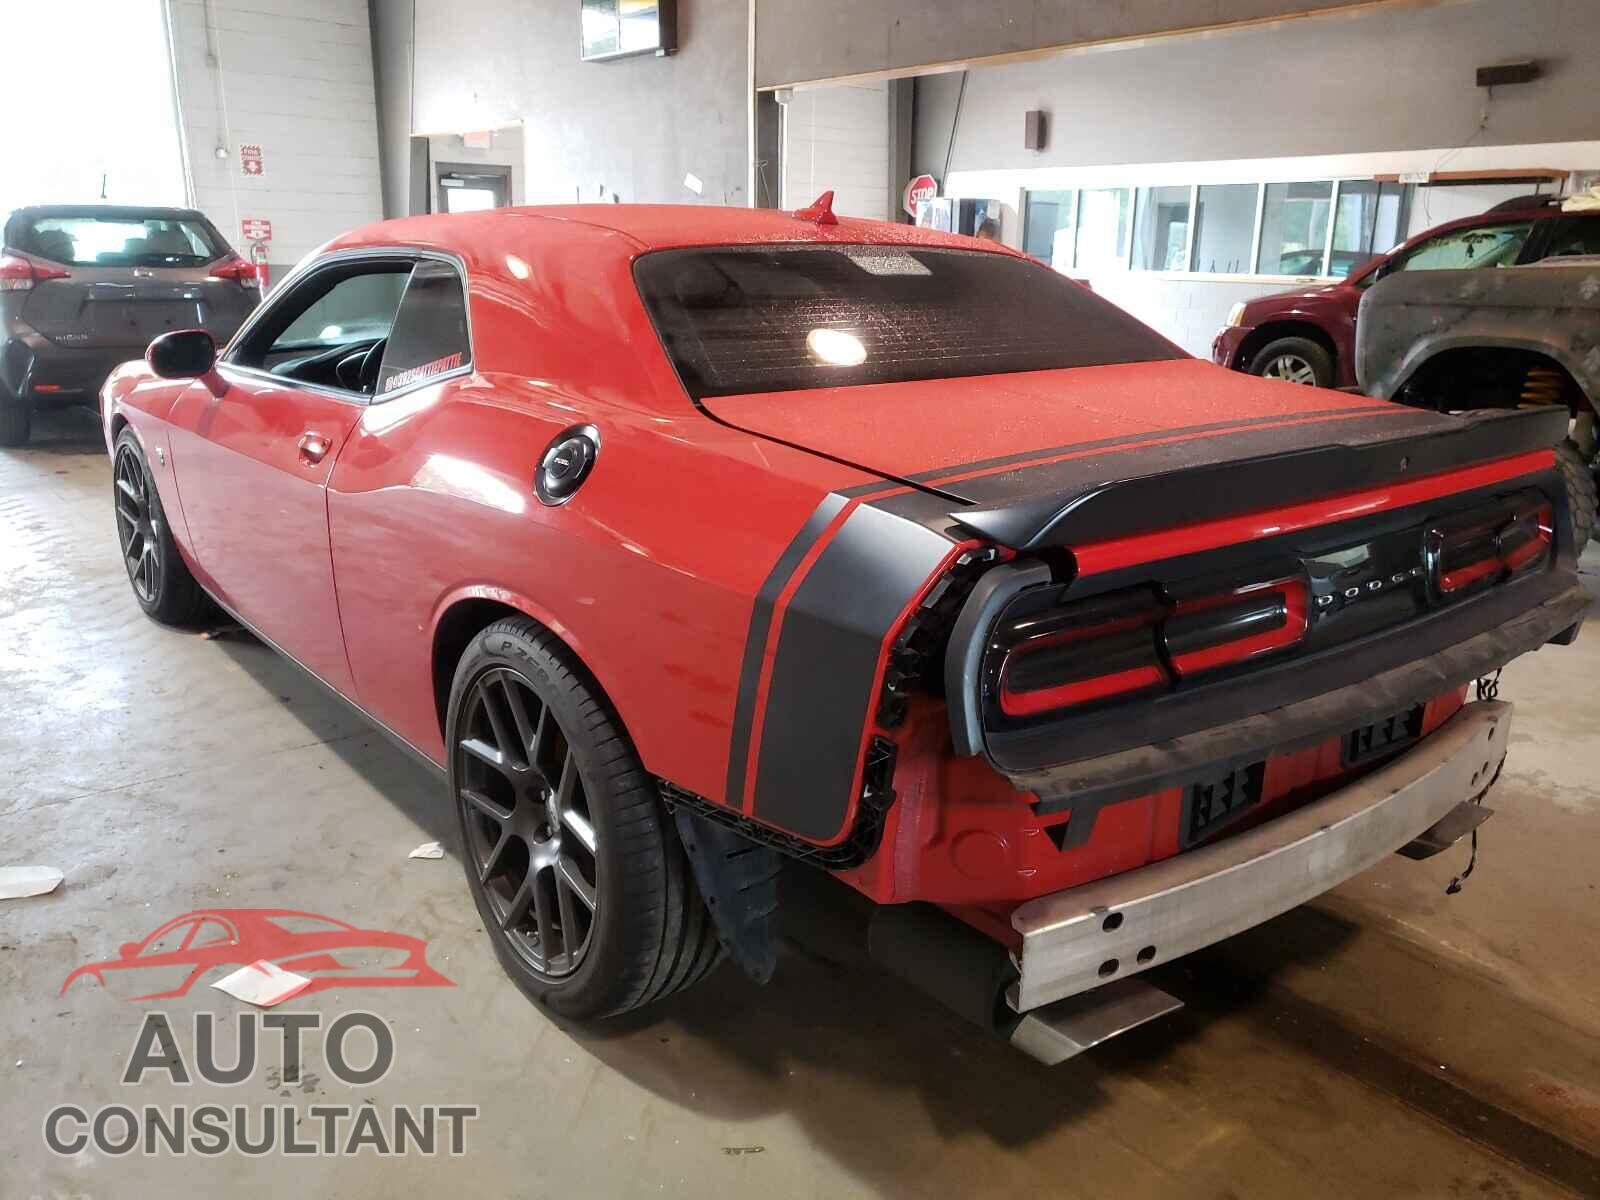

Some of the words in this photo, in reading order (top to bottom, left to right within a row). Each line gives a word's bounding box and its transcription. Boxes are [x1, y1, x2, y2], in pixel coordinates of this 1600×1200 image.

[910, 186, 935, 205] STOP
[1317, 567, 1424, 606] DODGE
[500, 640, 513, 651] P
